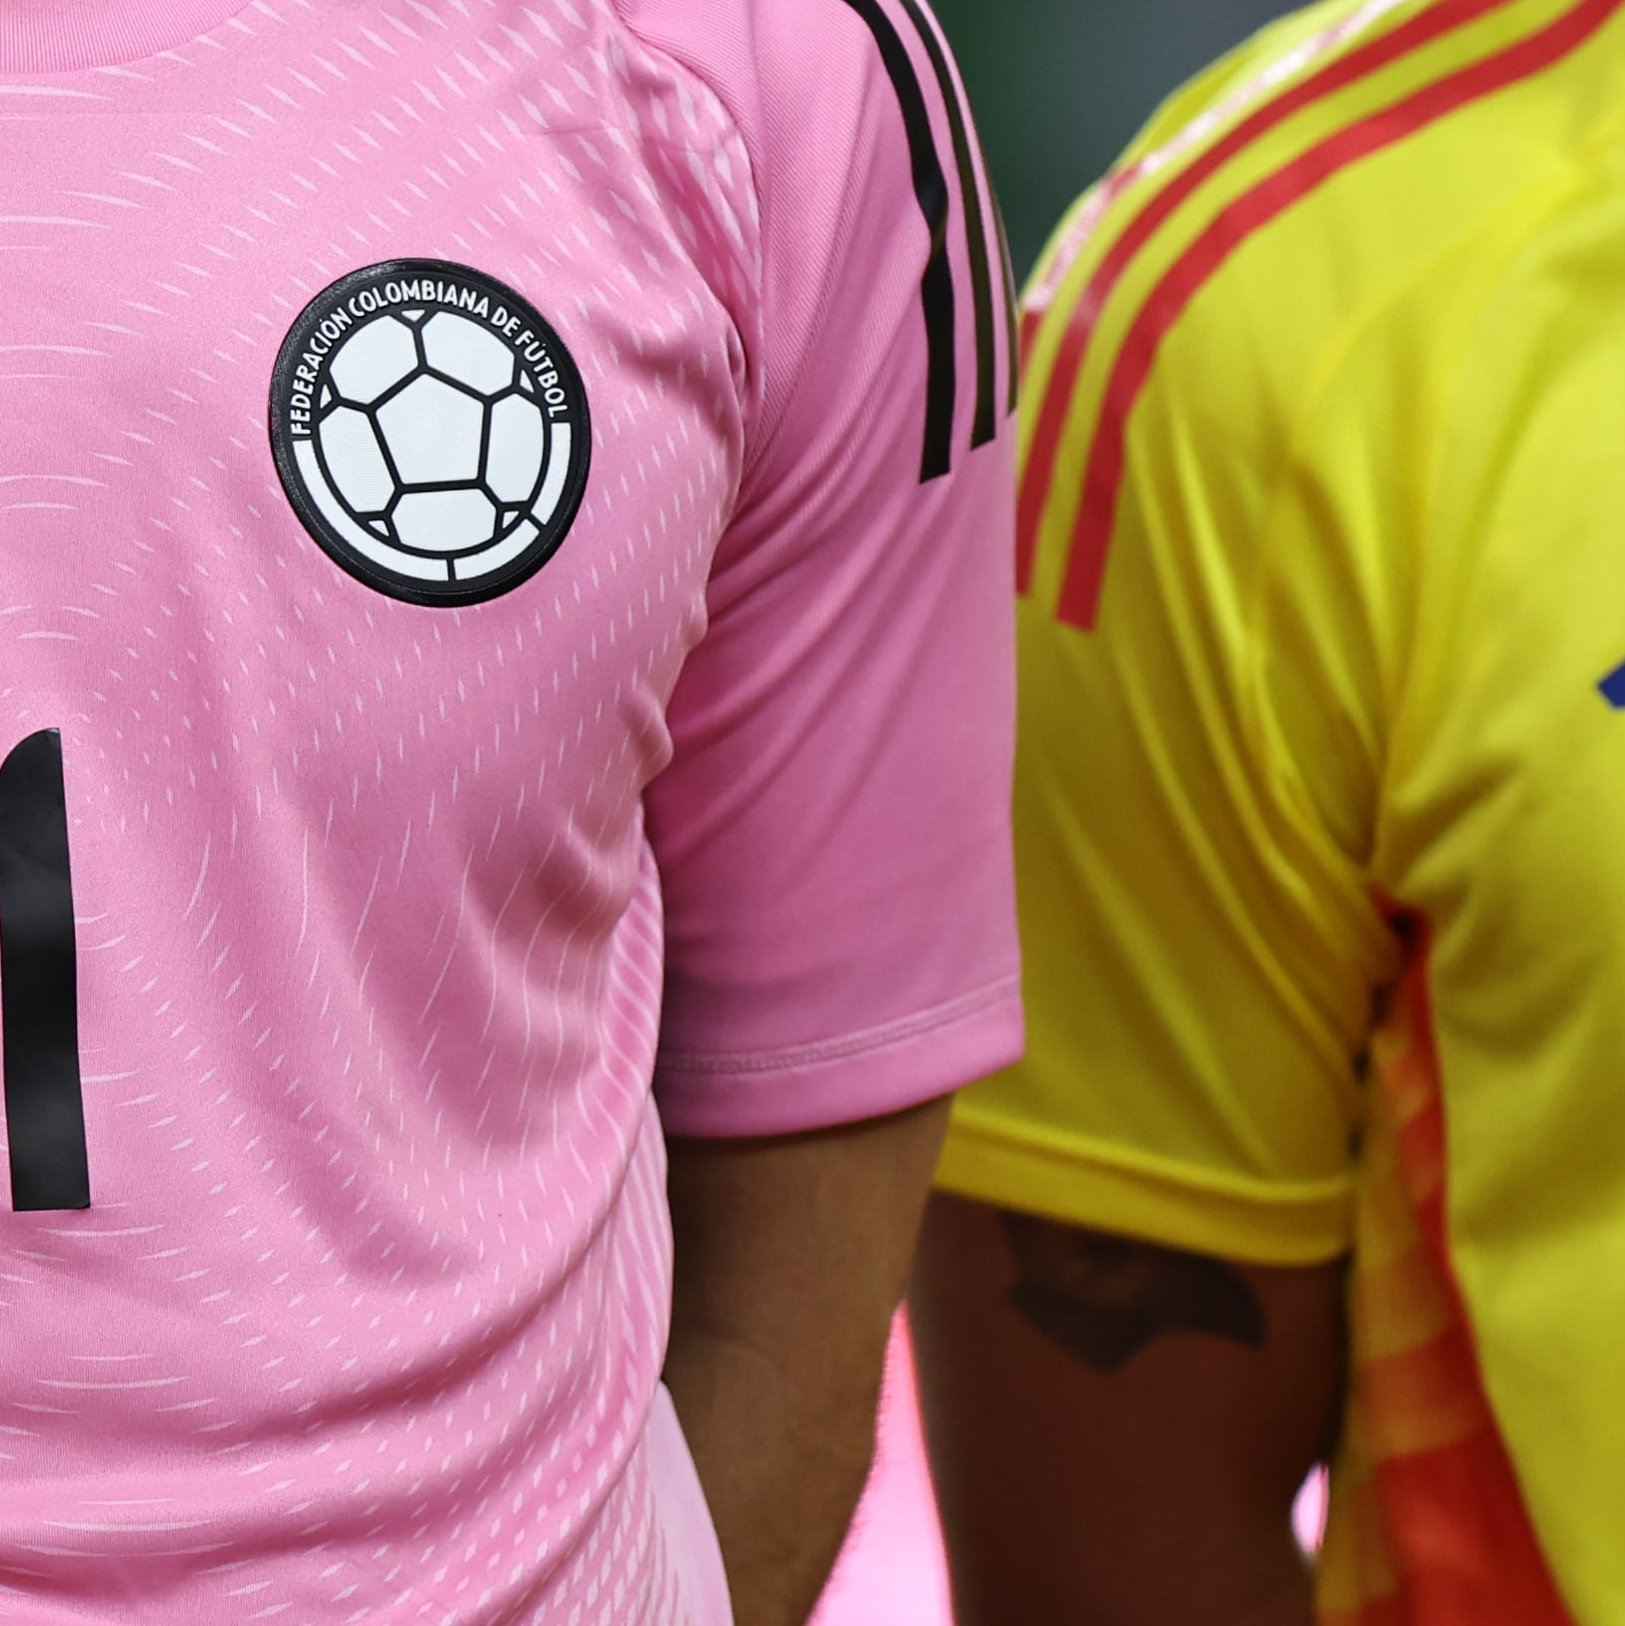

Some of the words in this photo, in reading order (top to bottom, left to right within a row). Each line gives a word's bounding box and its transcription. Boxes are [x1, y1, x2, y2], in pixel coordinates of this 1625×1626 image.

[290, 307, 353, 434] FEDERACIÓN
[348, 279, 489, 318] COLOMBIANA
[490, 306, 521, 337] DE
[514, 329, 568, 418] FÚTBOL
